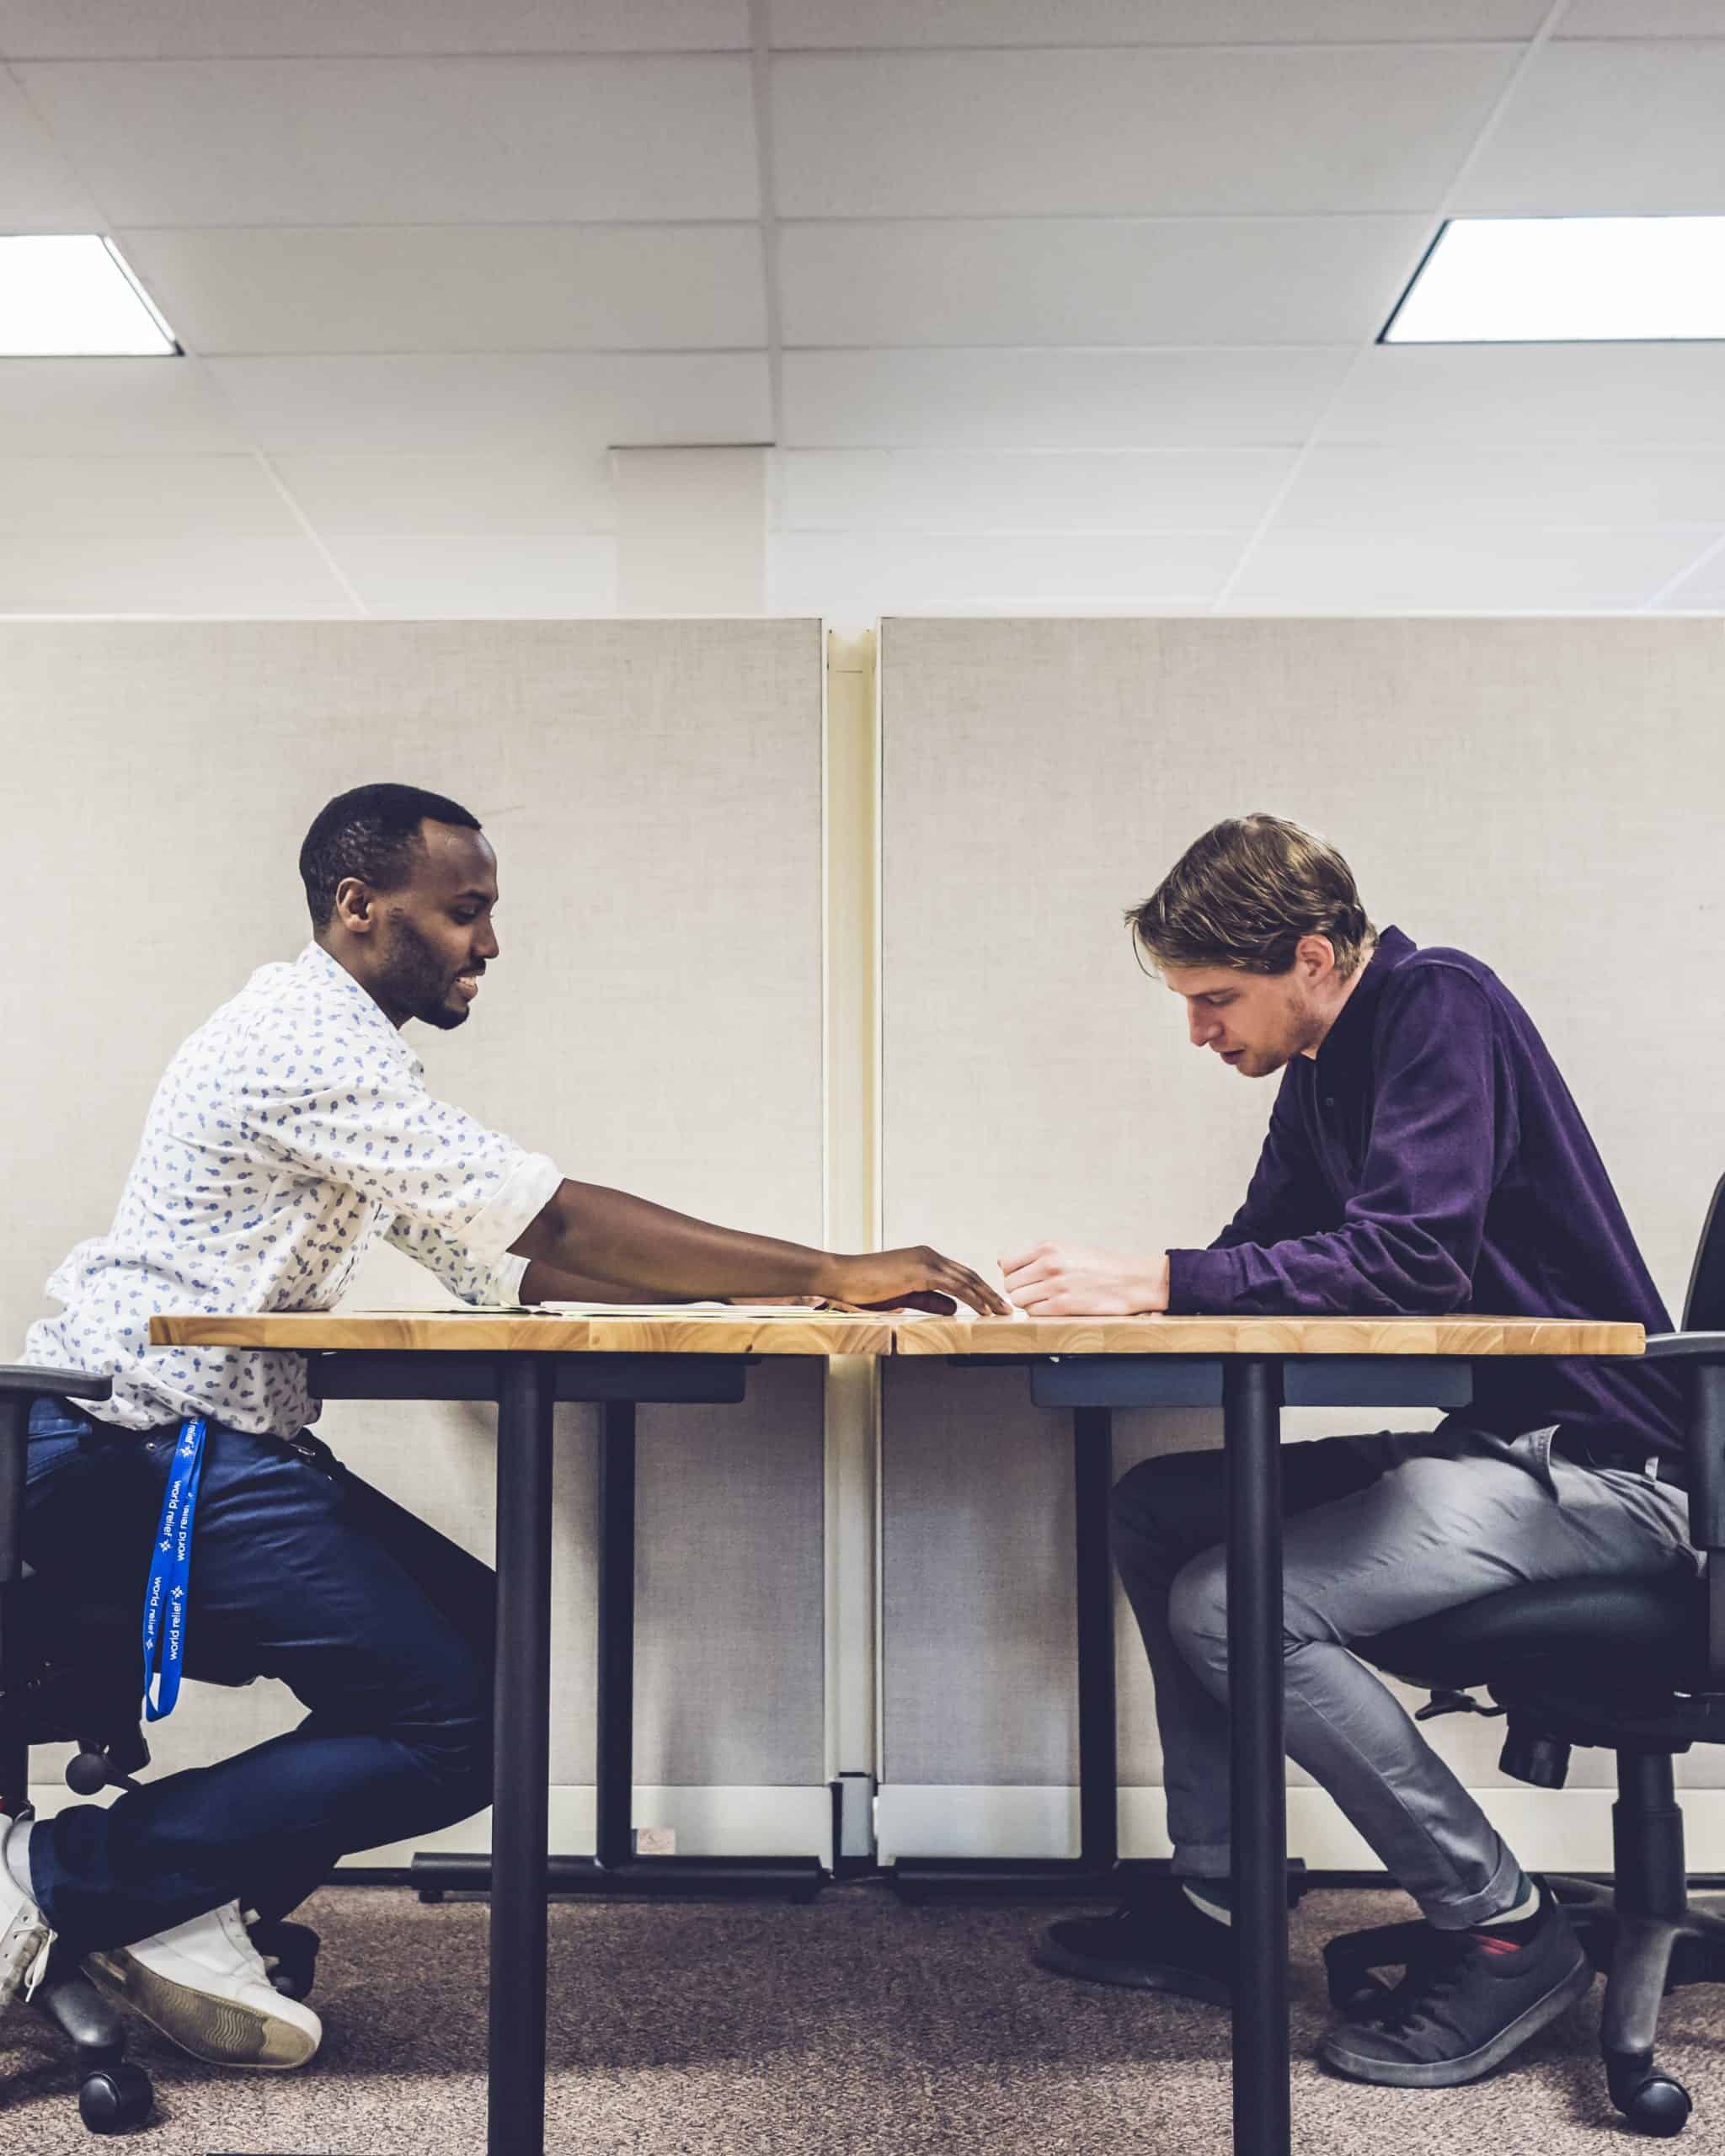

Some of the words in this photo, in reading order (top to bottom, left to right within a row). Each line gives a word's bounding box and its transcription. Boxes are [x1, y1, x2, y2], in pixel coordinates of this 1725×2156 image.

[168, 1481, 181, 1509] world
[163, 1511, 175, 1539] relief
[177, 1531, 187, 1561] world
[150, 1577, 163, 1607] world
[147, 1609, 156, 1636] relief
[171, 1599, 182, 1628] relief
[168, 1630, 180, 1661] world
